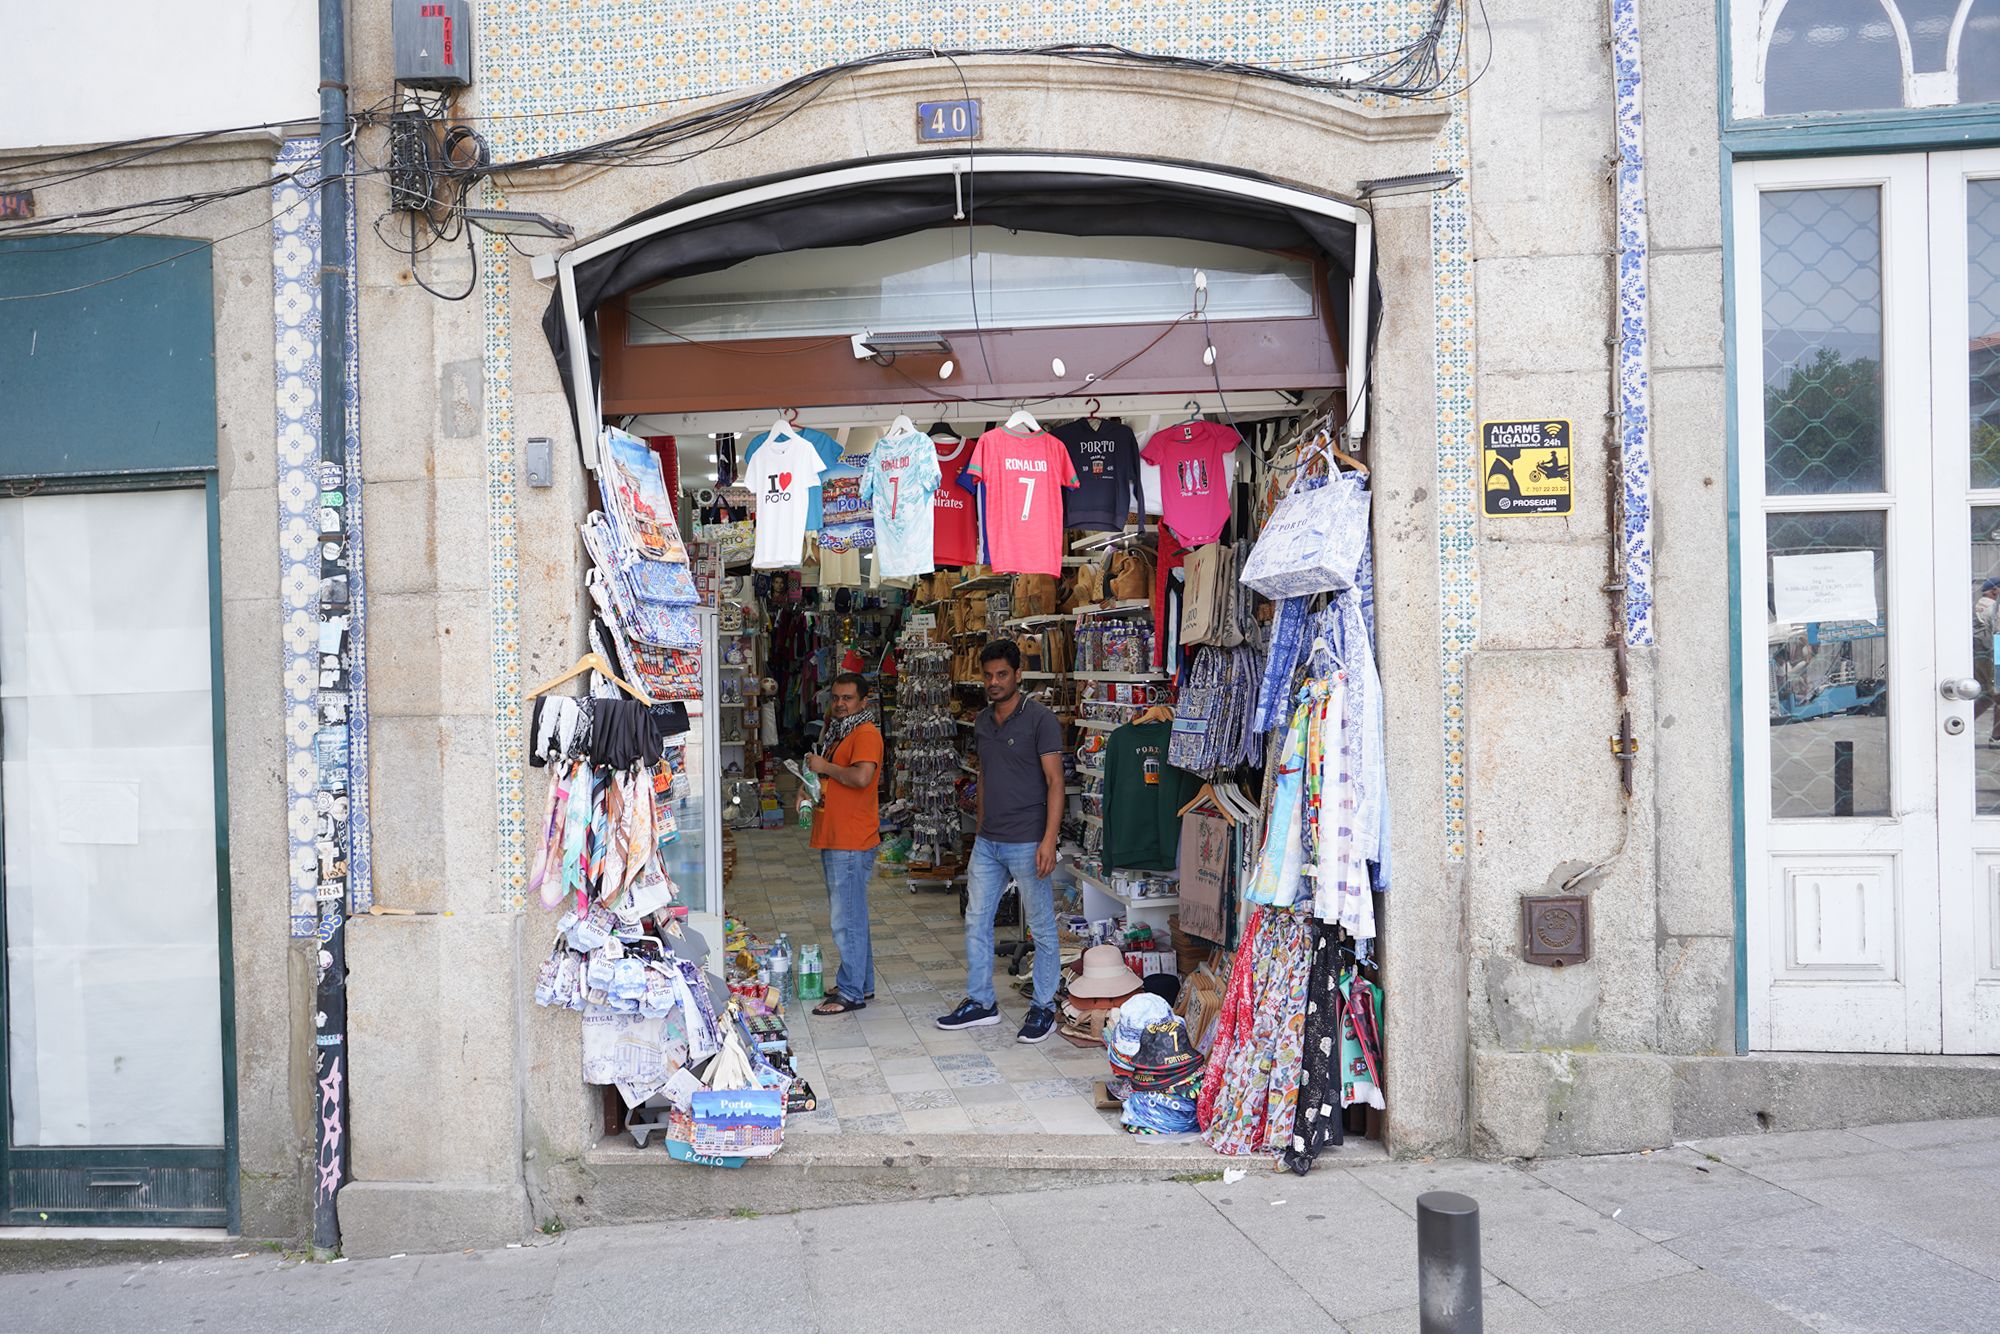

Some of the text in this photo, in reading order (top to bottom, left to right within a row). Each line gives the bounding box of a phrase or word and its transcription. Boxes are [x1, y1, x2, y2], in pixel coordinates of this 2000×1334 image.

[444, 17, 452, 64] 7161
[931, 107, 966, 133] 40
[1491, 424, 1540, 434] ALARME
[1491, 434, 1541, 444] LIGADO
[1543, 439, 1561, 447] 24h
[1080, 440, 1115, 454] PORTO
[881, 456, 910, 472] RONALDO
[1005, 458, 1048, 472] RONALDO
[768, 474, 779, 494] I
[889, 477, 899, 520] 7
[936, 489, 950, 498] Fly
[1018, 477, 1036, 520] 7
[1512, 499, 1557, 507] PROSEGUR
[1279, 519, 1308, 532] PORTO
[586, 924, 605, 937] Porto
[596, 960, 615, 970] Porto
[653, 989, 671, 997] Porto
[720, 1099, 752, 1109] Porto
[685, 1151, 724, 1166] PORTO
